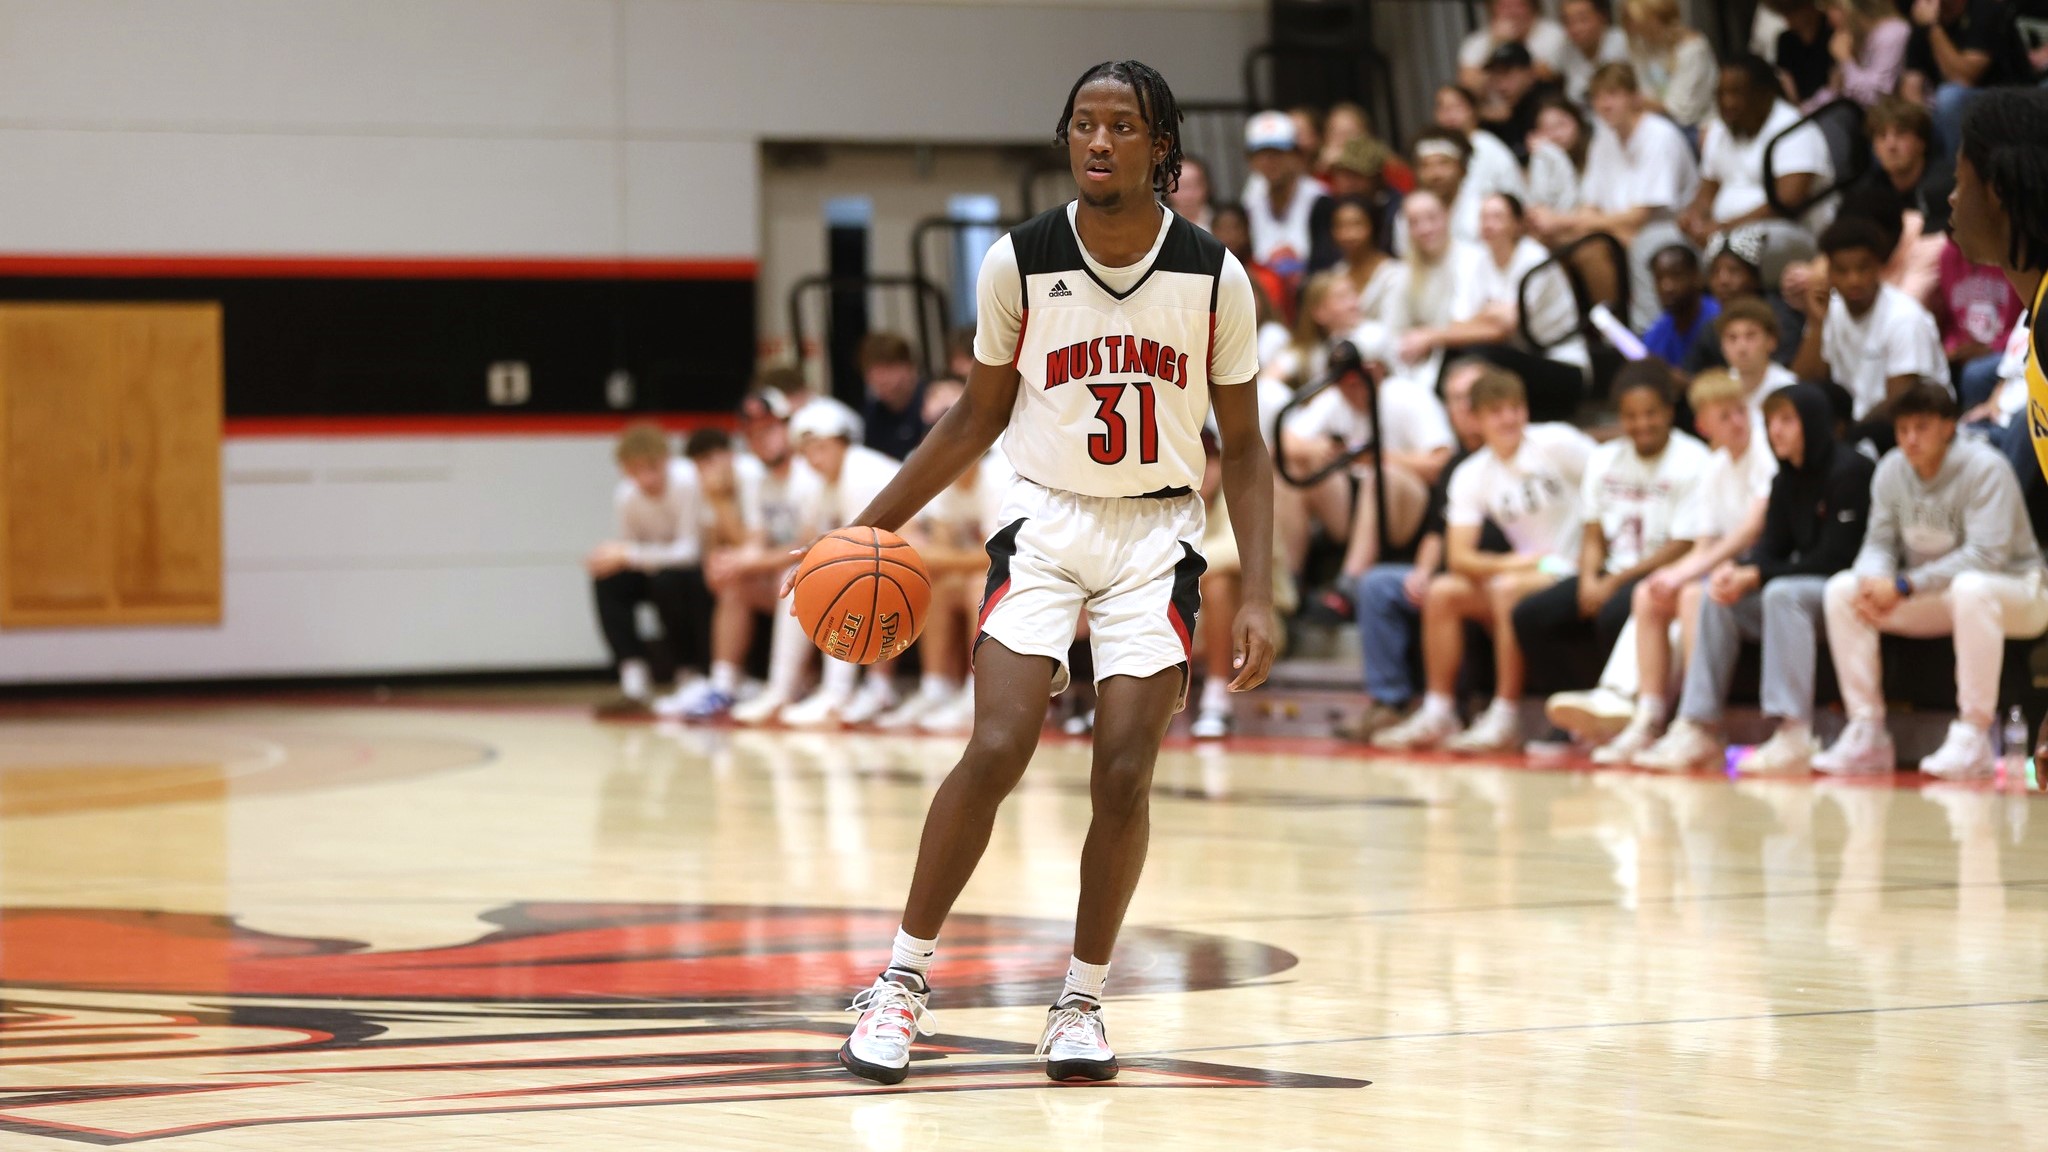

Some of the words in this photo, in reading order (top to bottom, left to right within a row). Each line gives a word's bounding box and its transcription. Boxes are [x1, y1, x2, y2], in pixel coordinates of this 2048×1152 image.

[1049, 290, 1072, 298] adidas
[1044, 335, 1189, 390] MUSTANGS
[1086, 382, 1158, 465] 31
